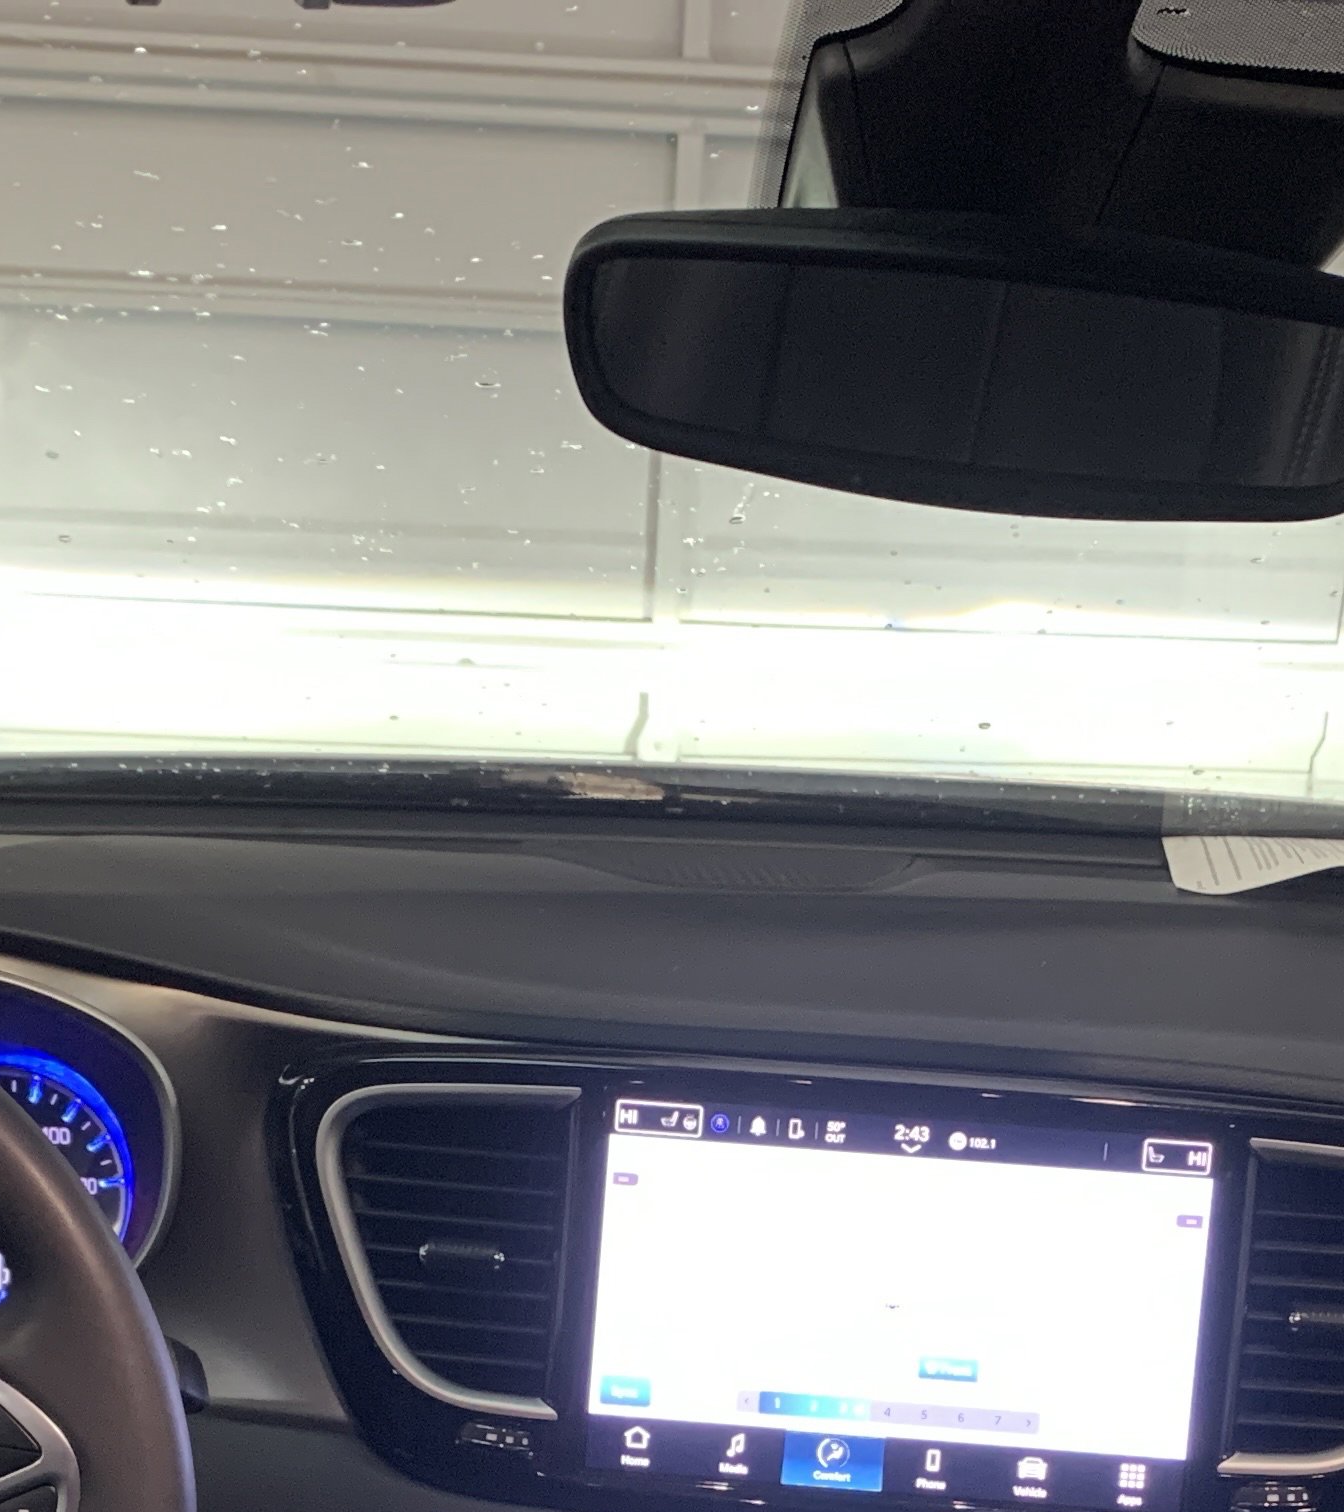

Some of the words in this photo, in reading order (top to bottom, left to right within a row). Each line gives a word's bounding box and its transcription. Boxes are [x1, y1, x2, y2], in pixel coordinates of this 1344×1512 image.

[619, 1108, 638, 1124] HI
[824, 1133, 847, 1144] OUT
[893, 1124, 930, 1142] 2:43
[968, 1137, 997, 1150] 102.1
[1187, 1150, 1208, 1167] HI
[920, 1410, 928, 1420] 5
[957, 1412, 965, 1423] 6
[994, 1415, 1002, 1426] 7
[620, 1454, 650, 1468] Home
[718, 1461, 748, 1475] Media
[812, 1469, 851, 1483] Comfort
[915, 1477, 946, 1491] Phone
[1012, 1485, 1048, 1499] Vehicle
